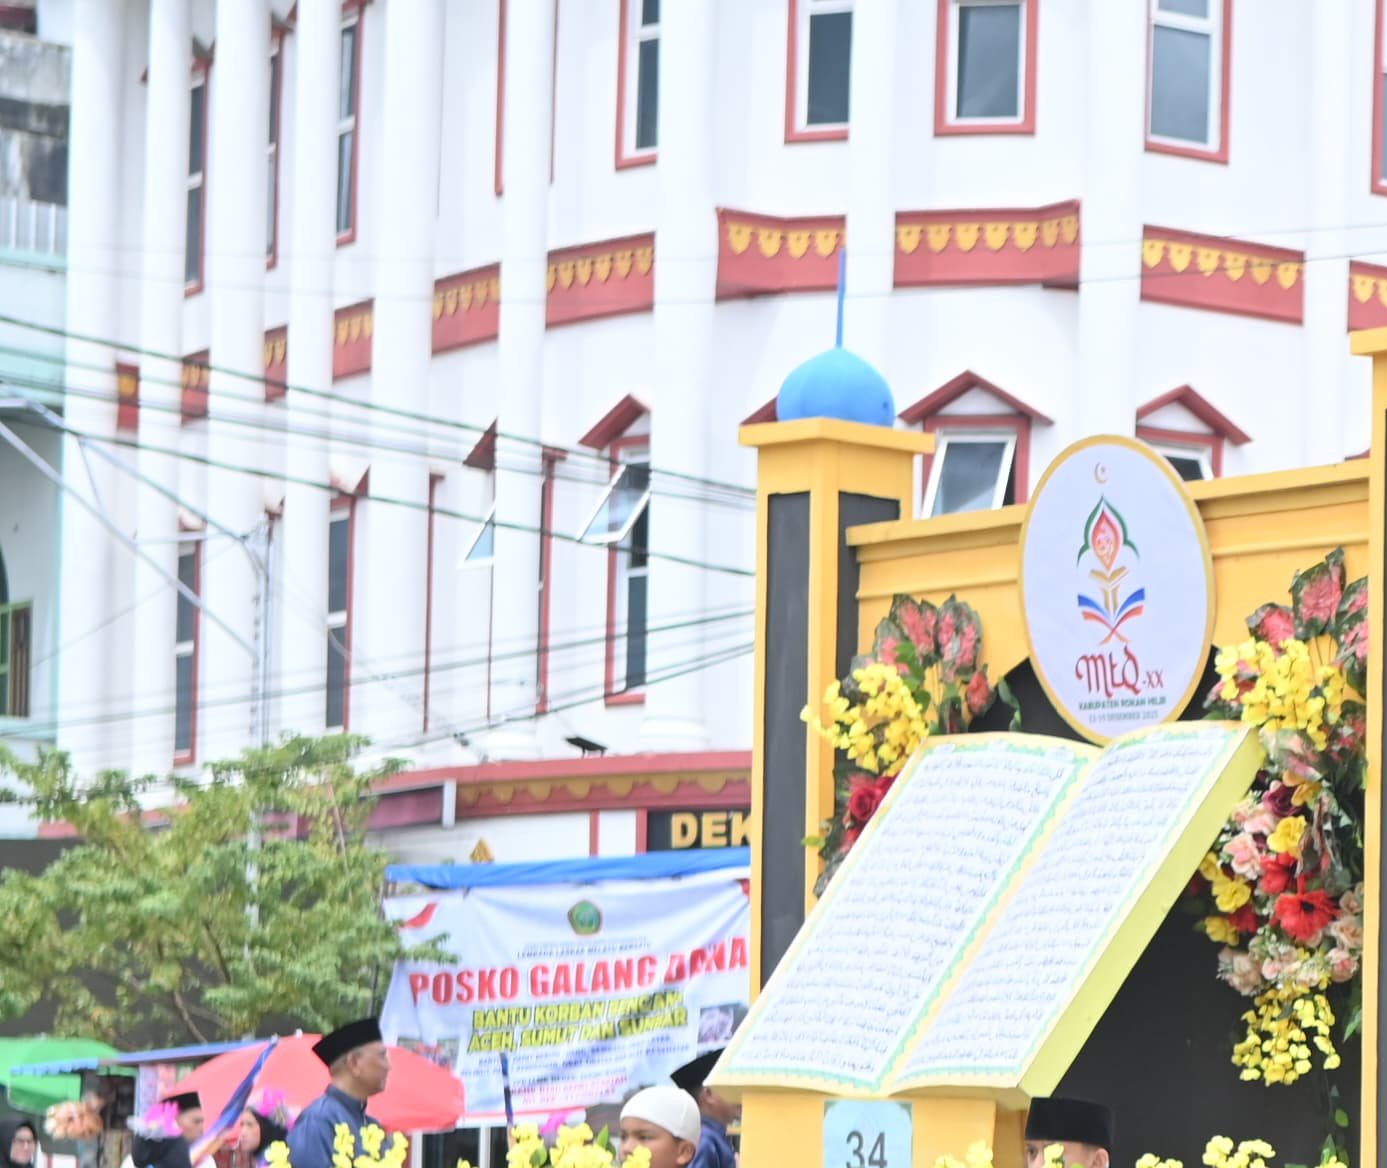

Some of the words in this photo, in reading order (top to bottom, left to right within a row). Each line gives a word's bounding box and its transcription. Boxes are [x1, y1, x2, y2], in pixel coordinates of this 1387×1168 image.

[409, 967, 519, 1006] POSKO
[529, 955, 658, 998] GALANG
[473, 1007, 531, 1029] BANTU
[534, 1000, 605, 1023] KORBAN
[520, 1025, 578, 1048] SUMUT
[579, 1020, 616, 1041] DAN
